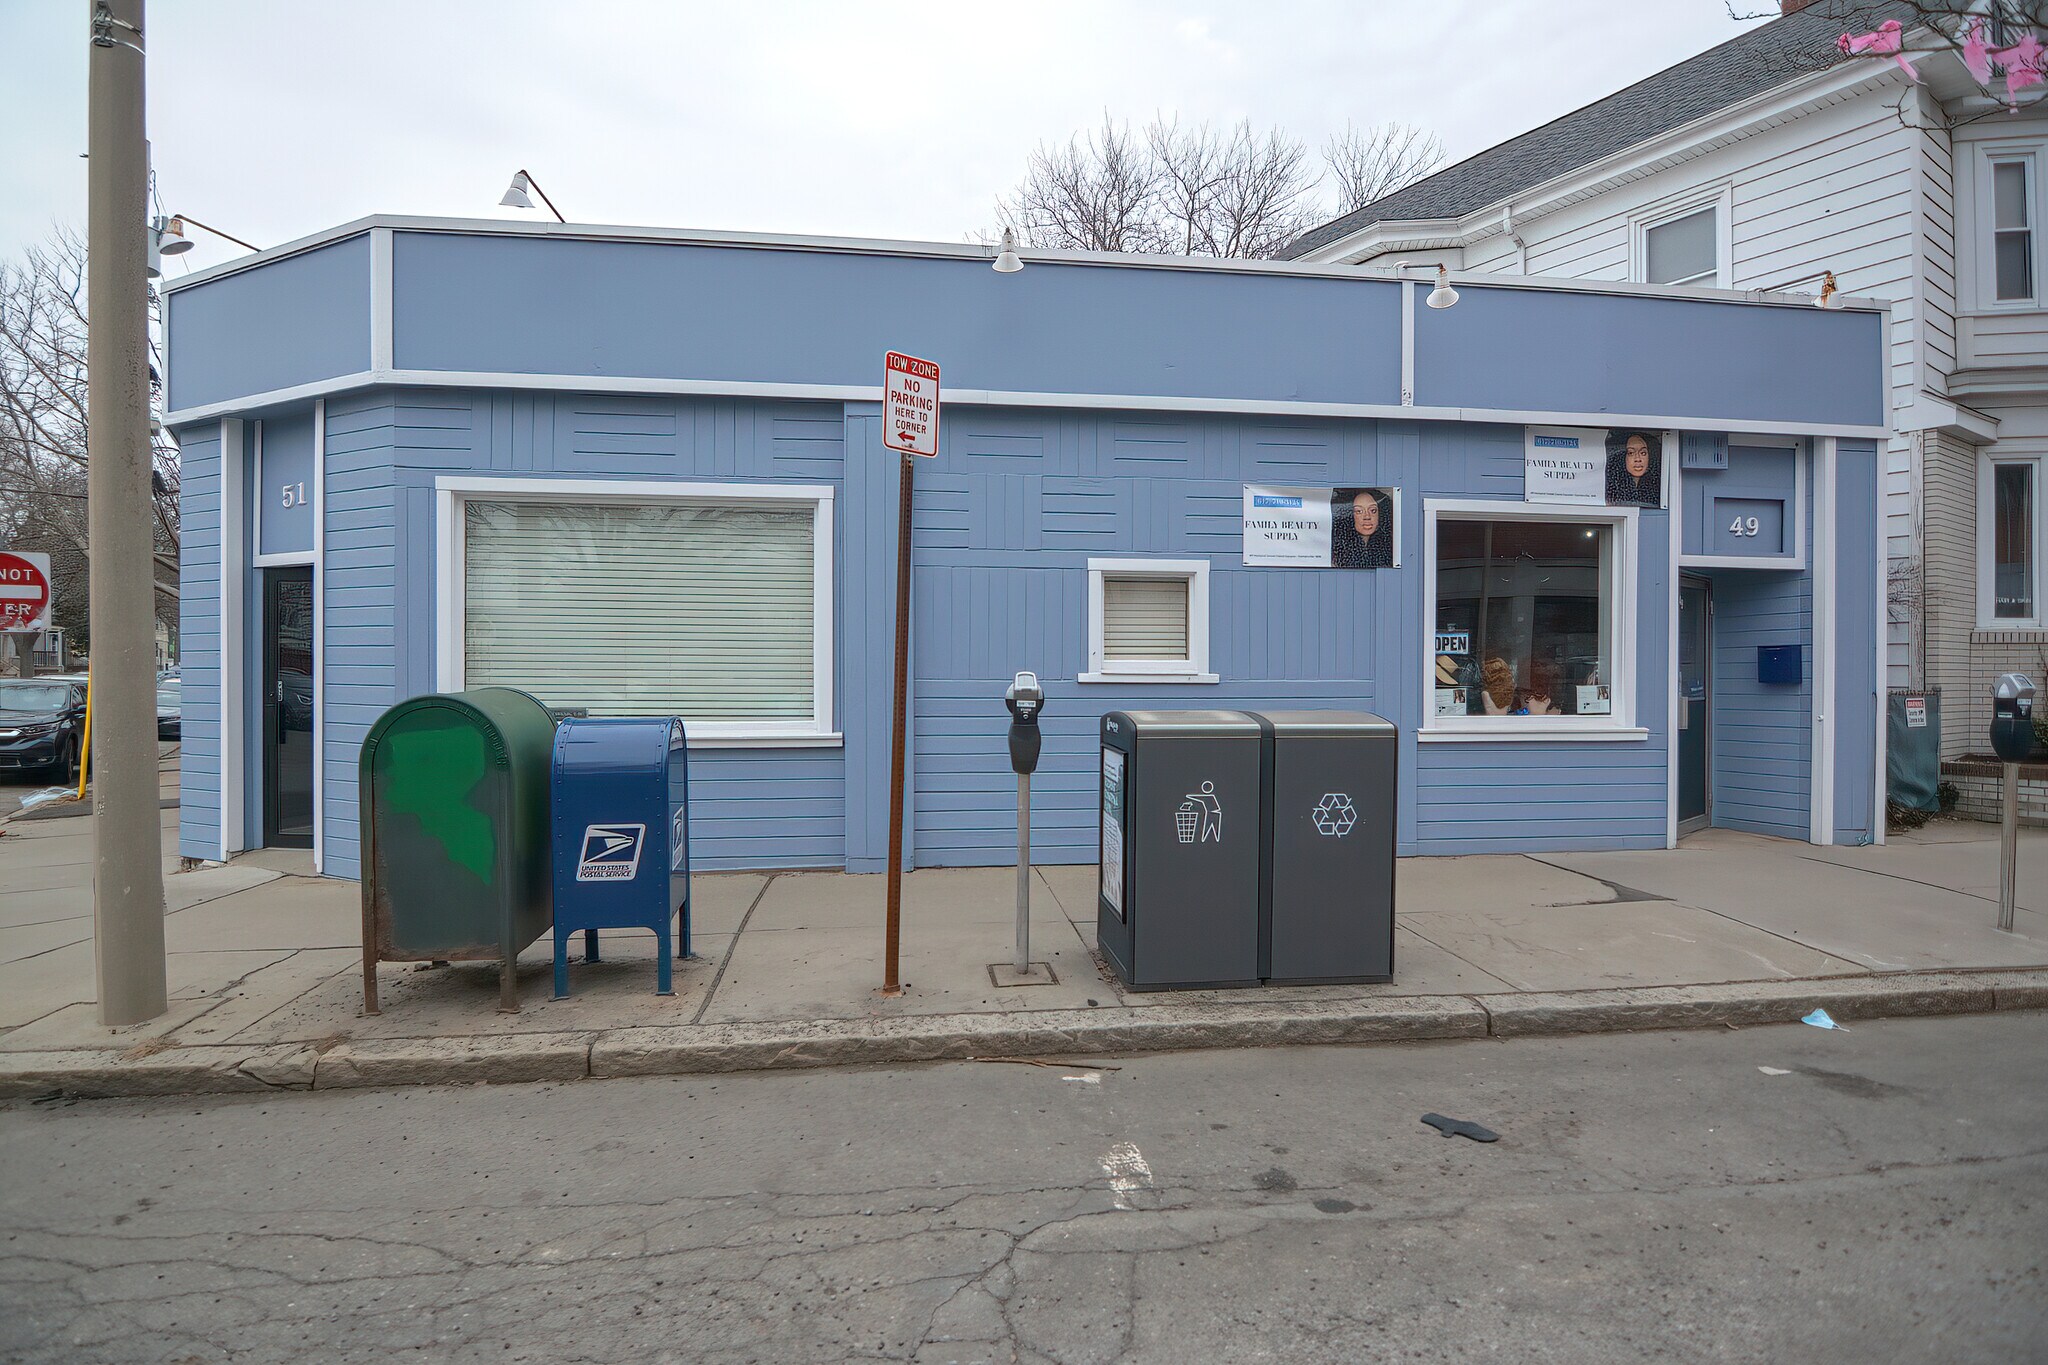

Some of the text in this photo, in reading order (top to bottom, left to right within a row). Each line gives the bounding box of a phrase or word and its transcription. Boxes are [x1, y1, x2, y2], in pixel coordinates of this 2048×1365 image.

[888, 354, 938, 379] TOW ZONE
[904, 378, 921, 393] NO
[891, 390, 933, 412] PARKING
[895, 406, 928, 423] HERE TO
[895, 419, 927, 435] CORNER
[1526, 459, 1595, 470] FAMILY BEAUTY
[1543, 471, 1577, 480] SUPPLY
[282, 482, 308, 508] 51
[1245, 520, 1320, 530] FAMILY BEAUTY
[1729, 516, 1759, 537] 49
[1263, 532, 1299, 541] SUPPLY
[1435, 636, 1467, 651] OPEN
